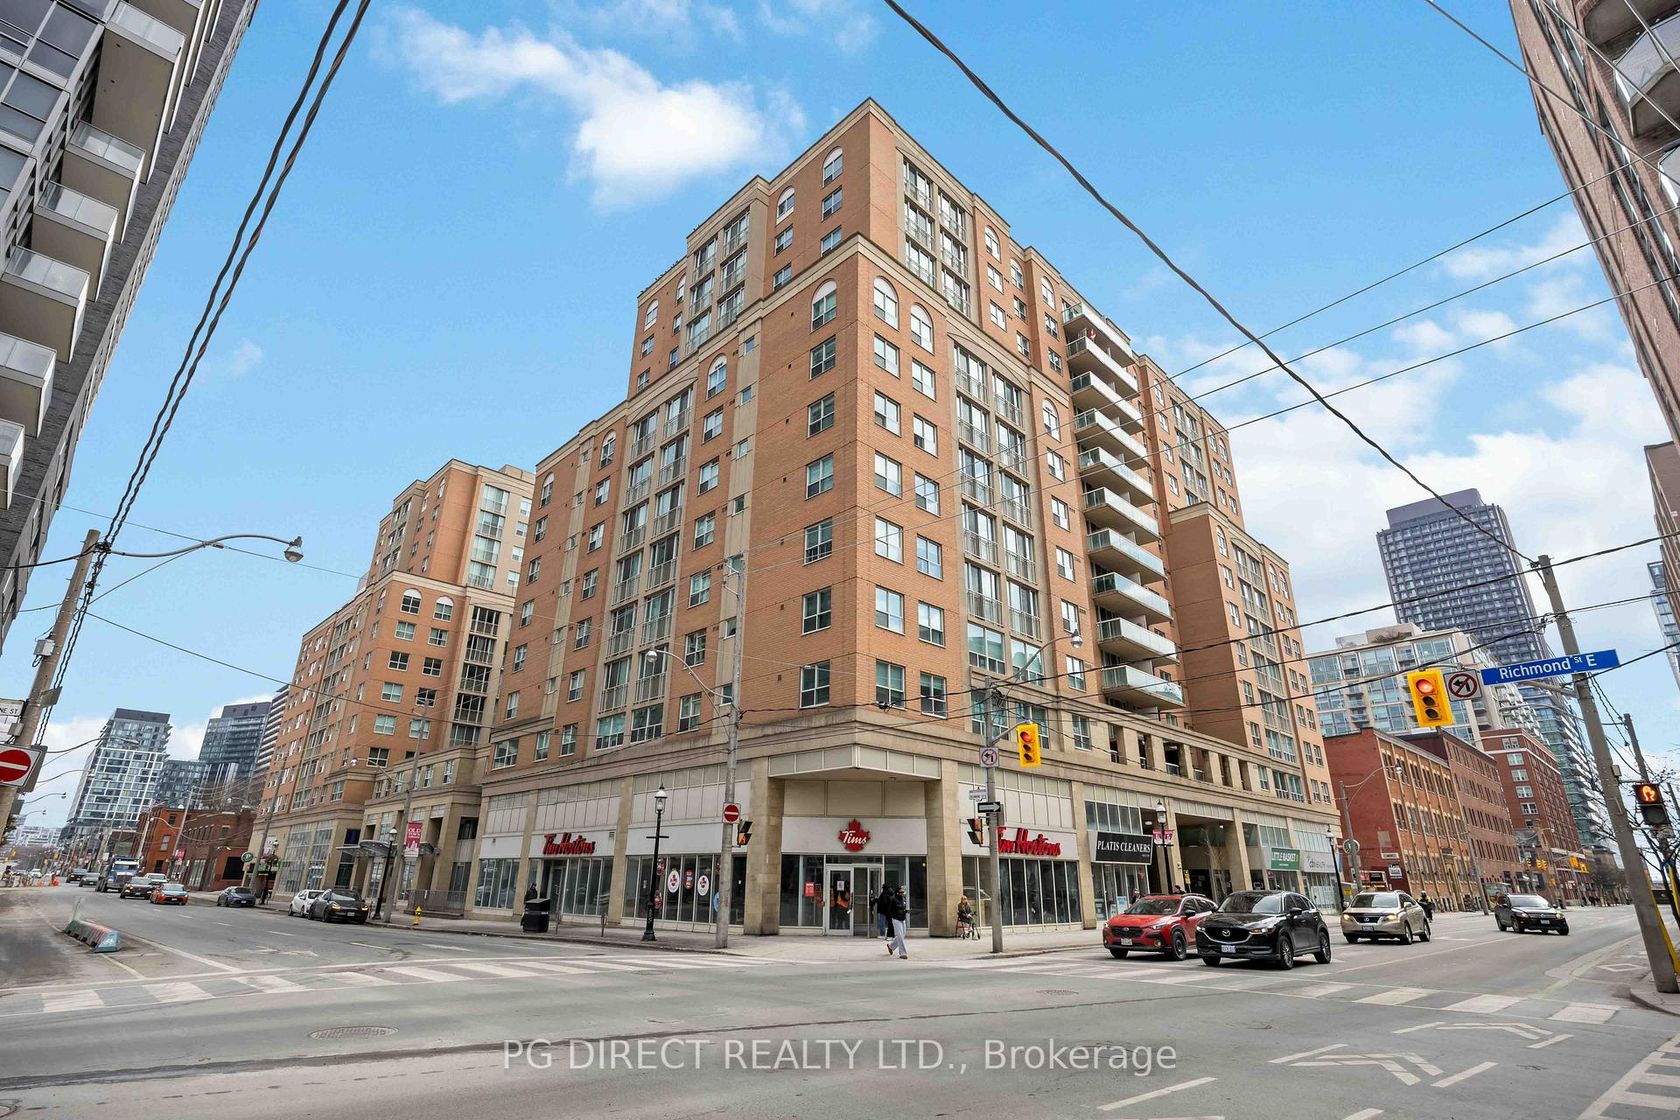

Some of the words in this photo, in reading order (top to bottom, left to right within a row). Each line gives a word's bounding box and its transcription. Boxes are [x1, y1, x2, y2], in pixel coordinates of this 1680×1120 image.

[1499, 658, 1572, 680] Richmond
[1573, 656, 1583, 664] St
[1585, 654, 1597, 667] E
[842, 830, 867, 844] Tims
[1014, 827, 1061, 856] Hortons
[1097, 840, 1120, 851] PLATIS
[1120, 841, 1151, 854] CLEANERS
[1283, 852, 1296, 862] BASKET
